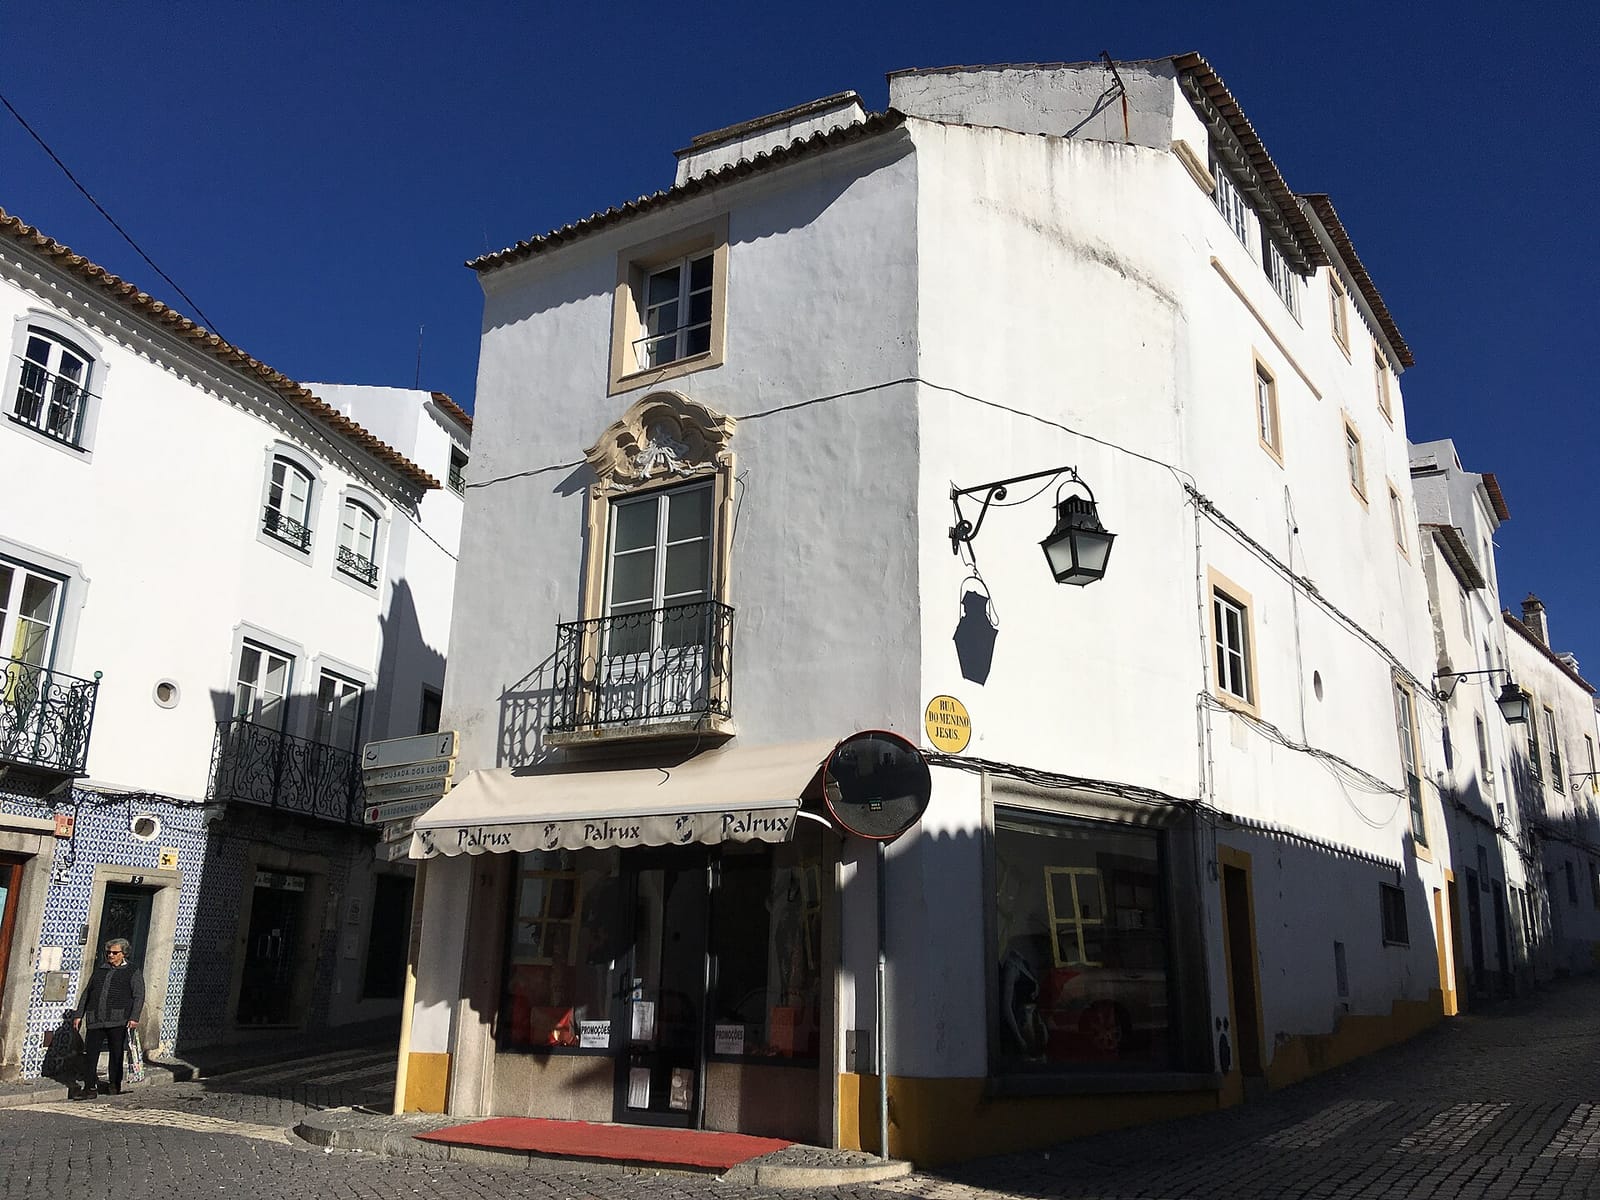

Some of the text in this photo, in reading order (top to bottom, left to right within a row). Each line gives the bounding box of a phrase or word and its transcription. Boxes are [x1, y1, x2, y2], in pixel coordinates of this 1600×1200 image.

[940, 700, 955, 712] RUA
[929, 711, 969, 727] DO MENINO
[380, 770, 409, 779] POUSADA
[411, 767, 425, 776] DOS
[584, 820, 640, 841] Palrux
[721, 812, 788, 833] Palrux
[457, 828, 511, 847] Palrux
[581, 1024, 610, 1036] PROMOÇÕES
